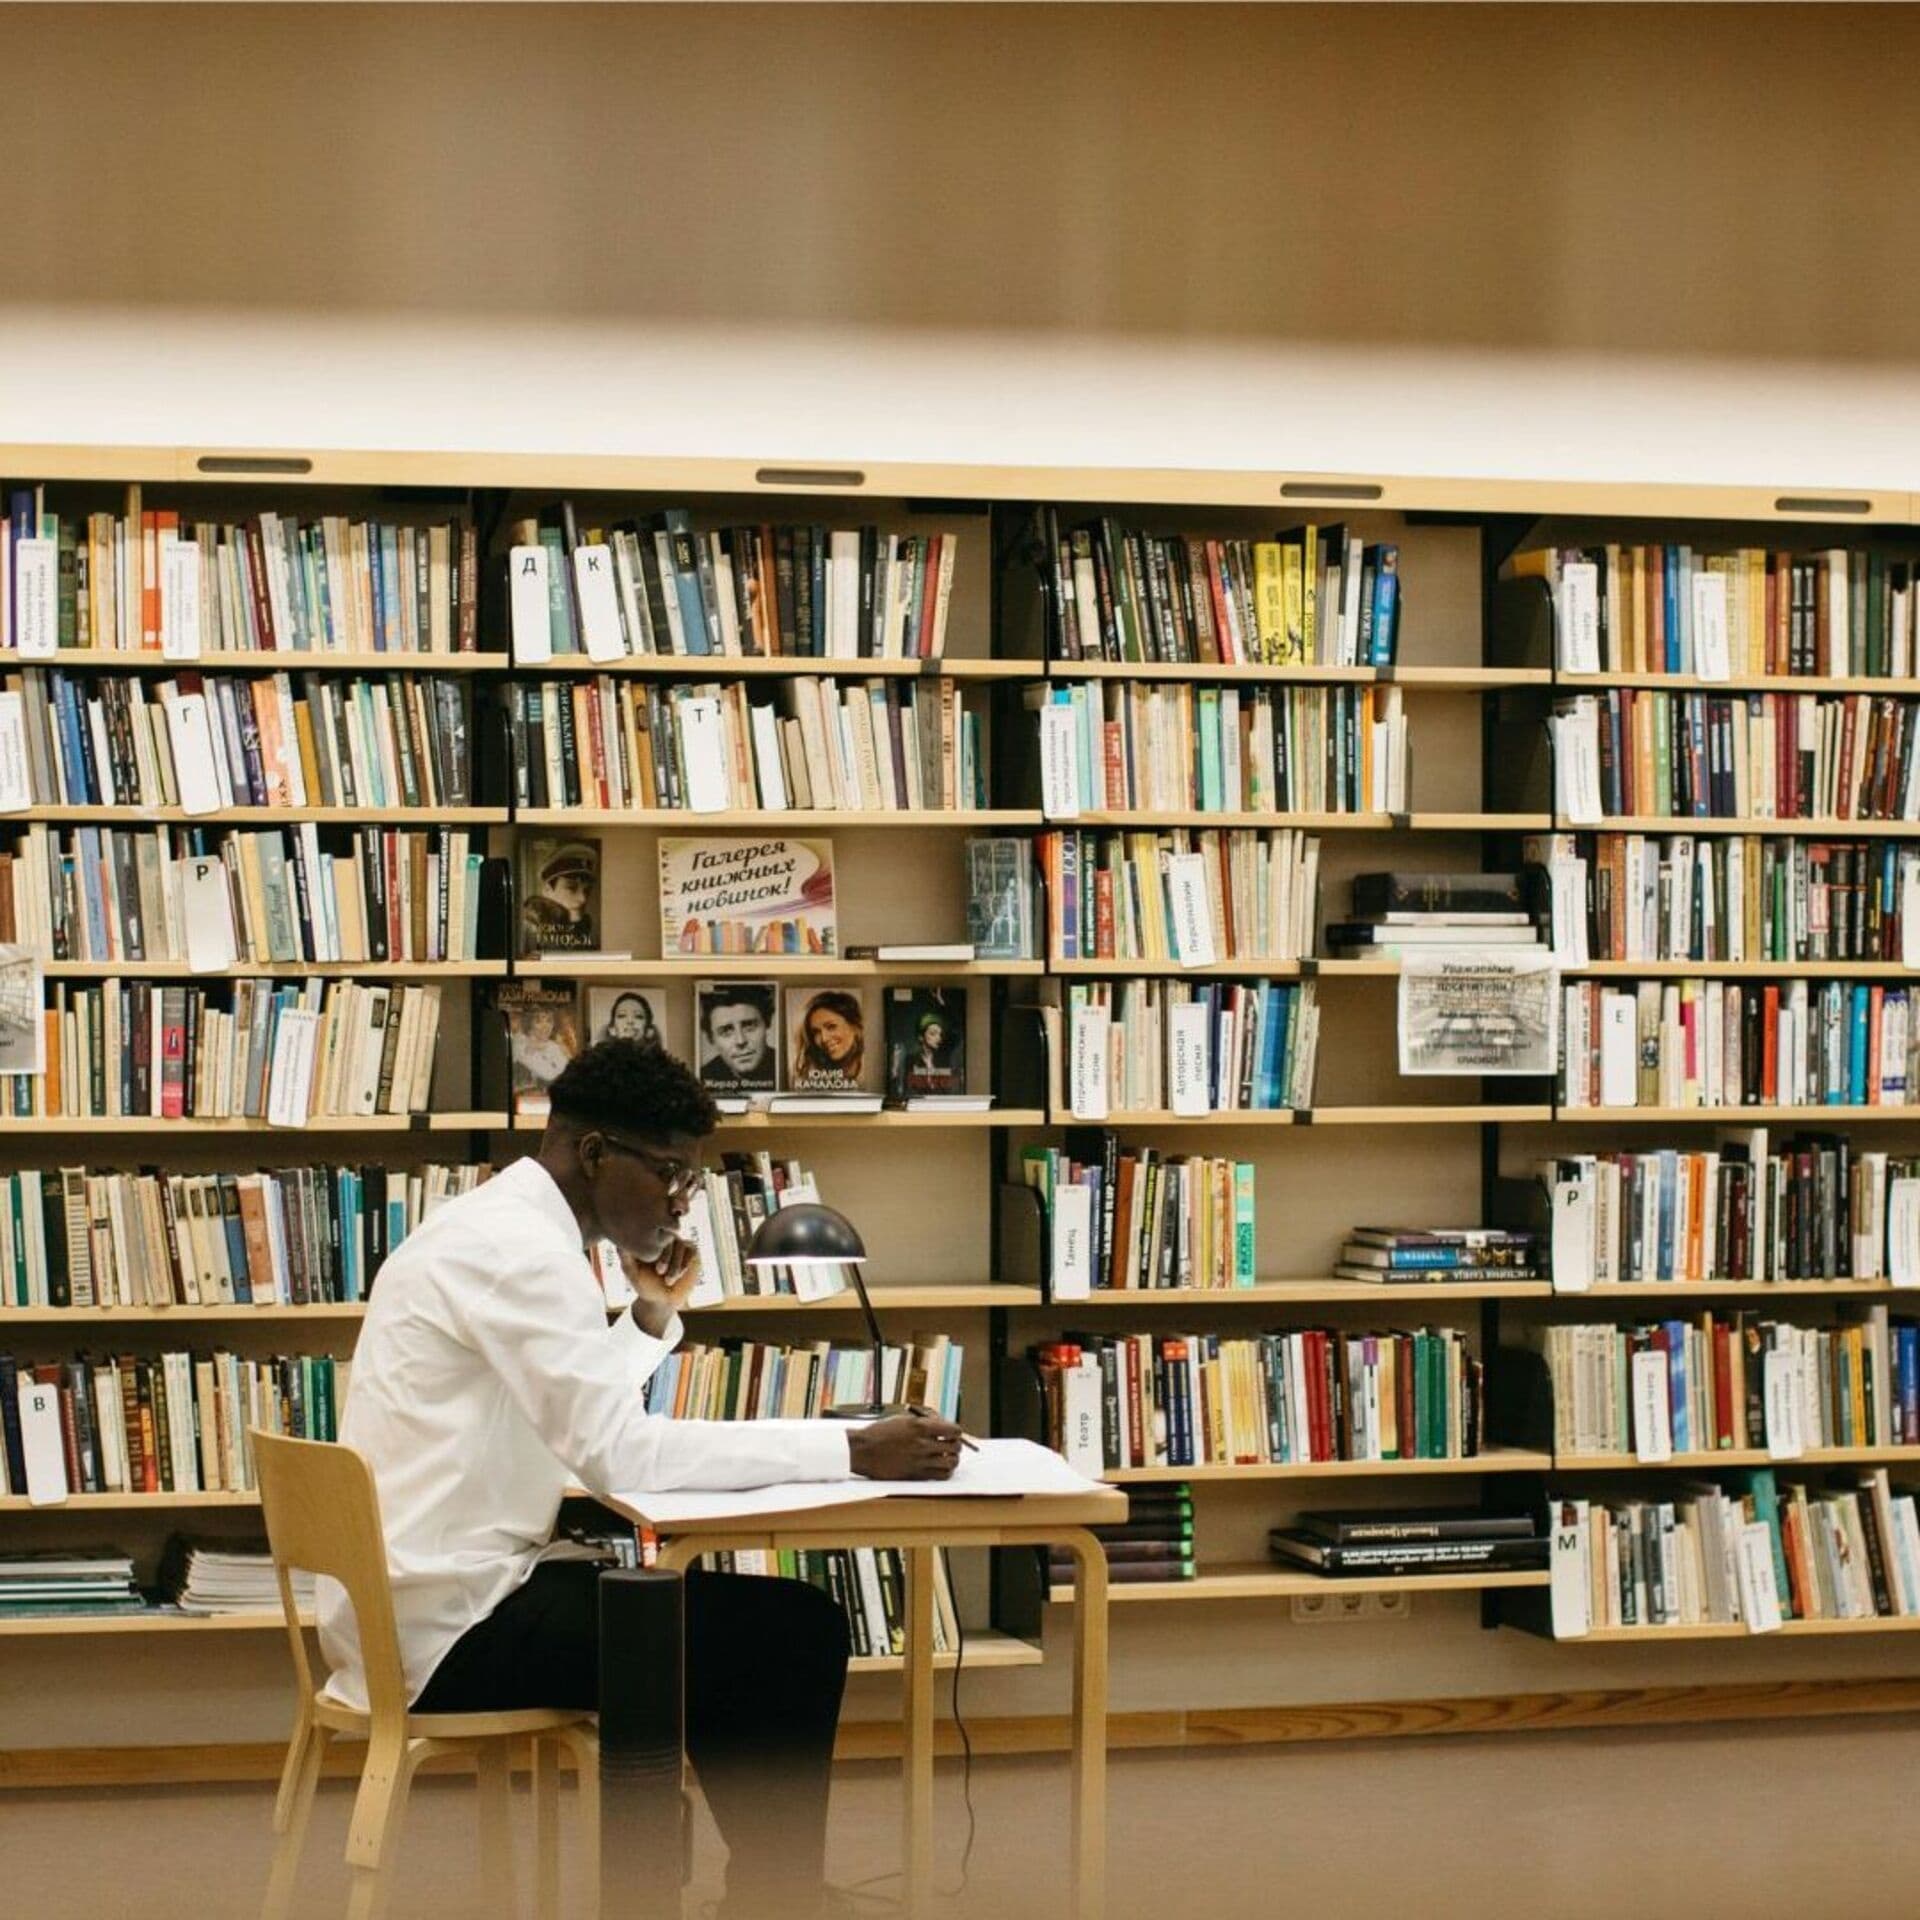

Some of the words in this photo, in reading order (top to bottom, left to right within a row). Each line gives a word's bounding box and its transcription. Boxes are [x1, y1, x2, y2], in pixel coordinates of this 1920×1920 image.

[523, 558, 536, 574] Д
[588, 557, 598, 571] К
[695, 709, 703, 722] Т
[692, 842, 787, 870] Галерея
[196, 865, 208, 880] Р
[681, 858, 796, 895] книжных
[687, 876, 792, 914] новинок!
[1442, 964, 1515, 974] Уважаемые
[807, 1069, 844, 1080] ЮЛИЯ
[1065, 1229, 1077, 1267] Танец
[34, 1397, 45, 1411] В
[1077, 1412, 1089, 1449] Театр
[1559, 1534, 1576, 1550] М
